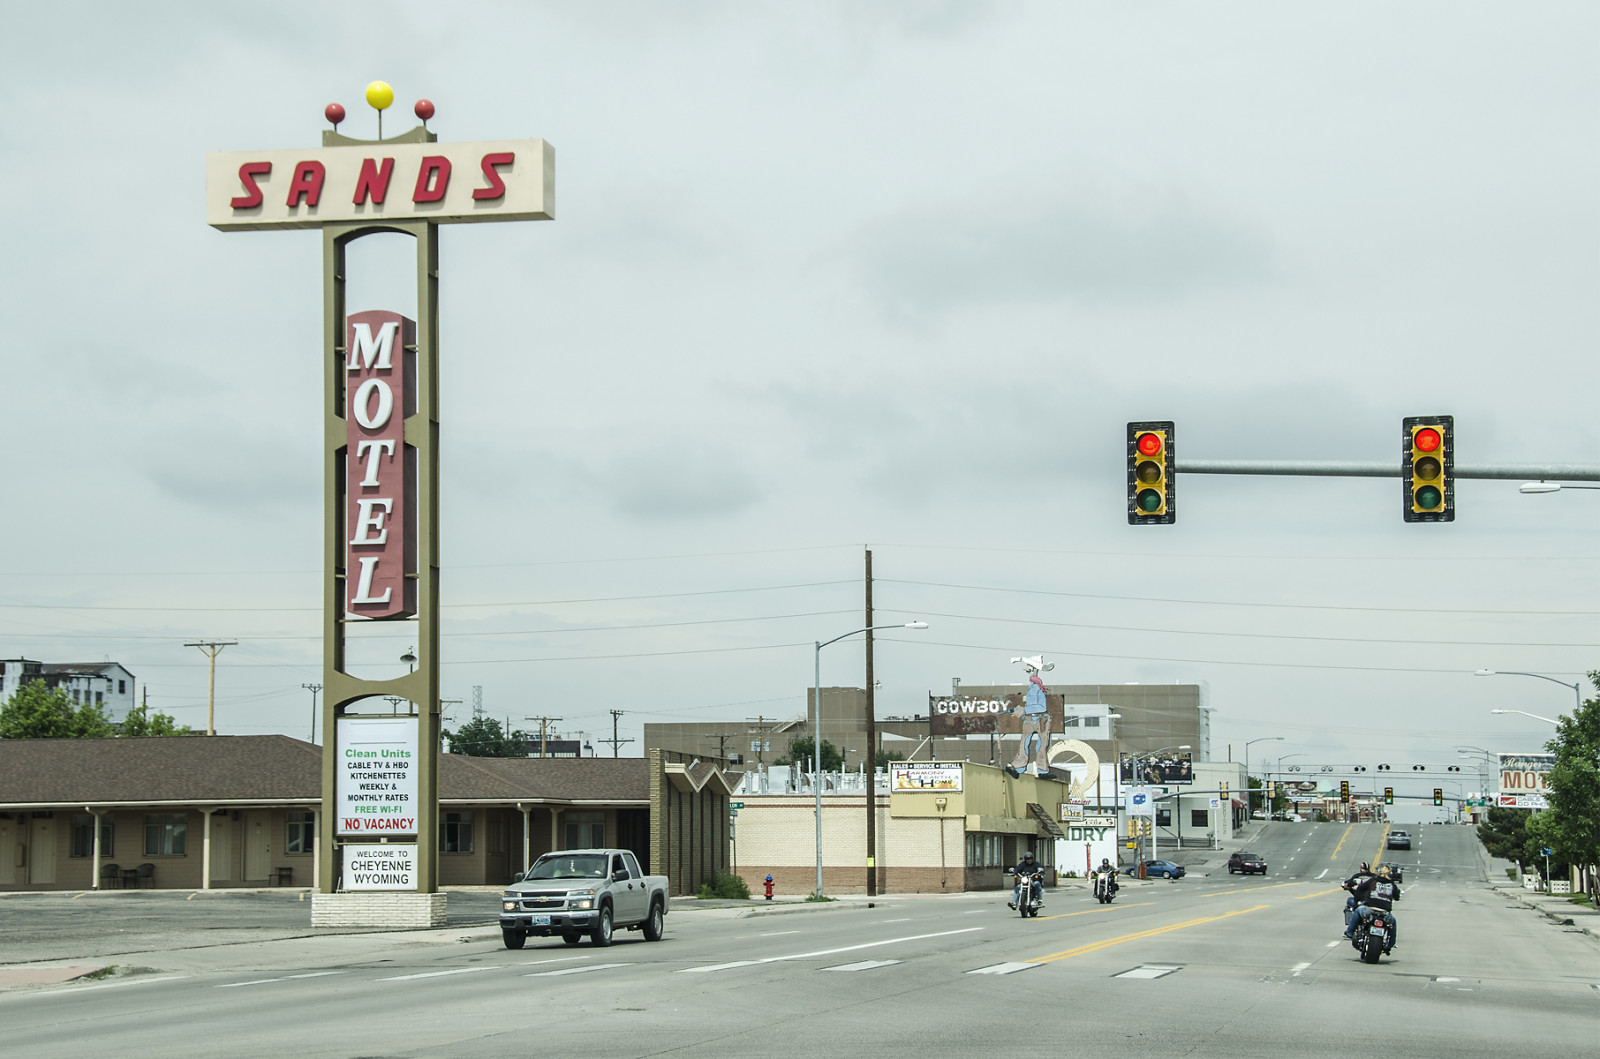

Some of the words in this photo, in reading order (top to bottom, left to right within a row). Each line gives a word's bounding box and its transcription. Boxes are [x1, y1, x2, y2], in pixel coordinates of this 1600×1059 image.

[230, 152, 515, 209] SANDS
[347, 321, 399, 604] MOTEL
[937, 700, 1012, 714] COWBOY
[345, 749, 377, 758] Clean
[381, 749, 411, 758] Units
[392, 761, 409, 769] HBO
[1503, 757, 1543, 771] Ranger
[350, 772, 406, 780] KITCHENETTES
[897, 770, 945, 779] HARMONY
[359, 783, 389, 791] WEEKLY
[354, 805, 377, 814] FREE
[380, 805, 402, 814] WI-FI
[345, 818, 360, 830] NO
[364, 818, 414, 830] VACANCY
[398, 850, 408, 858] TO
[351, 860, 412, 871] CHEYENNE
[354, 874, 409, 885] WYOMING
